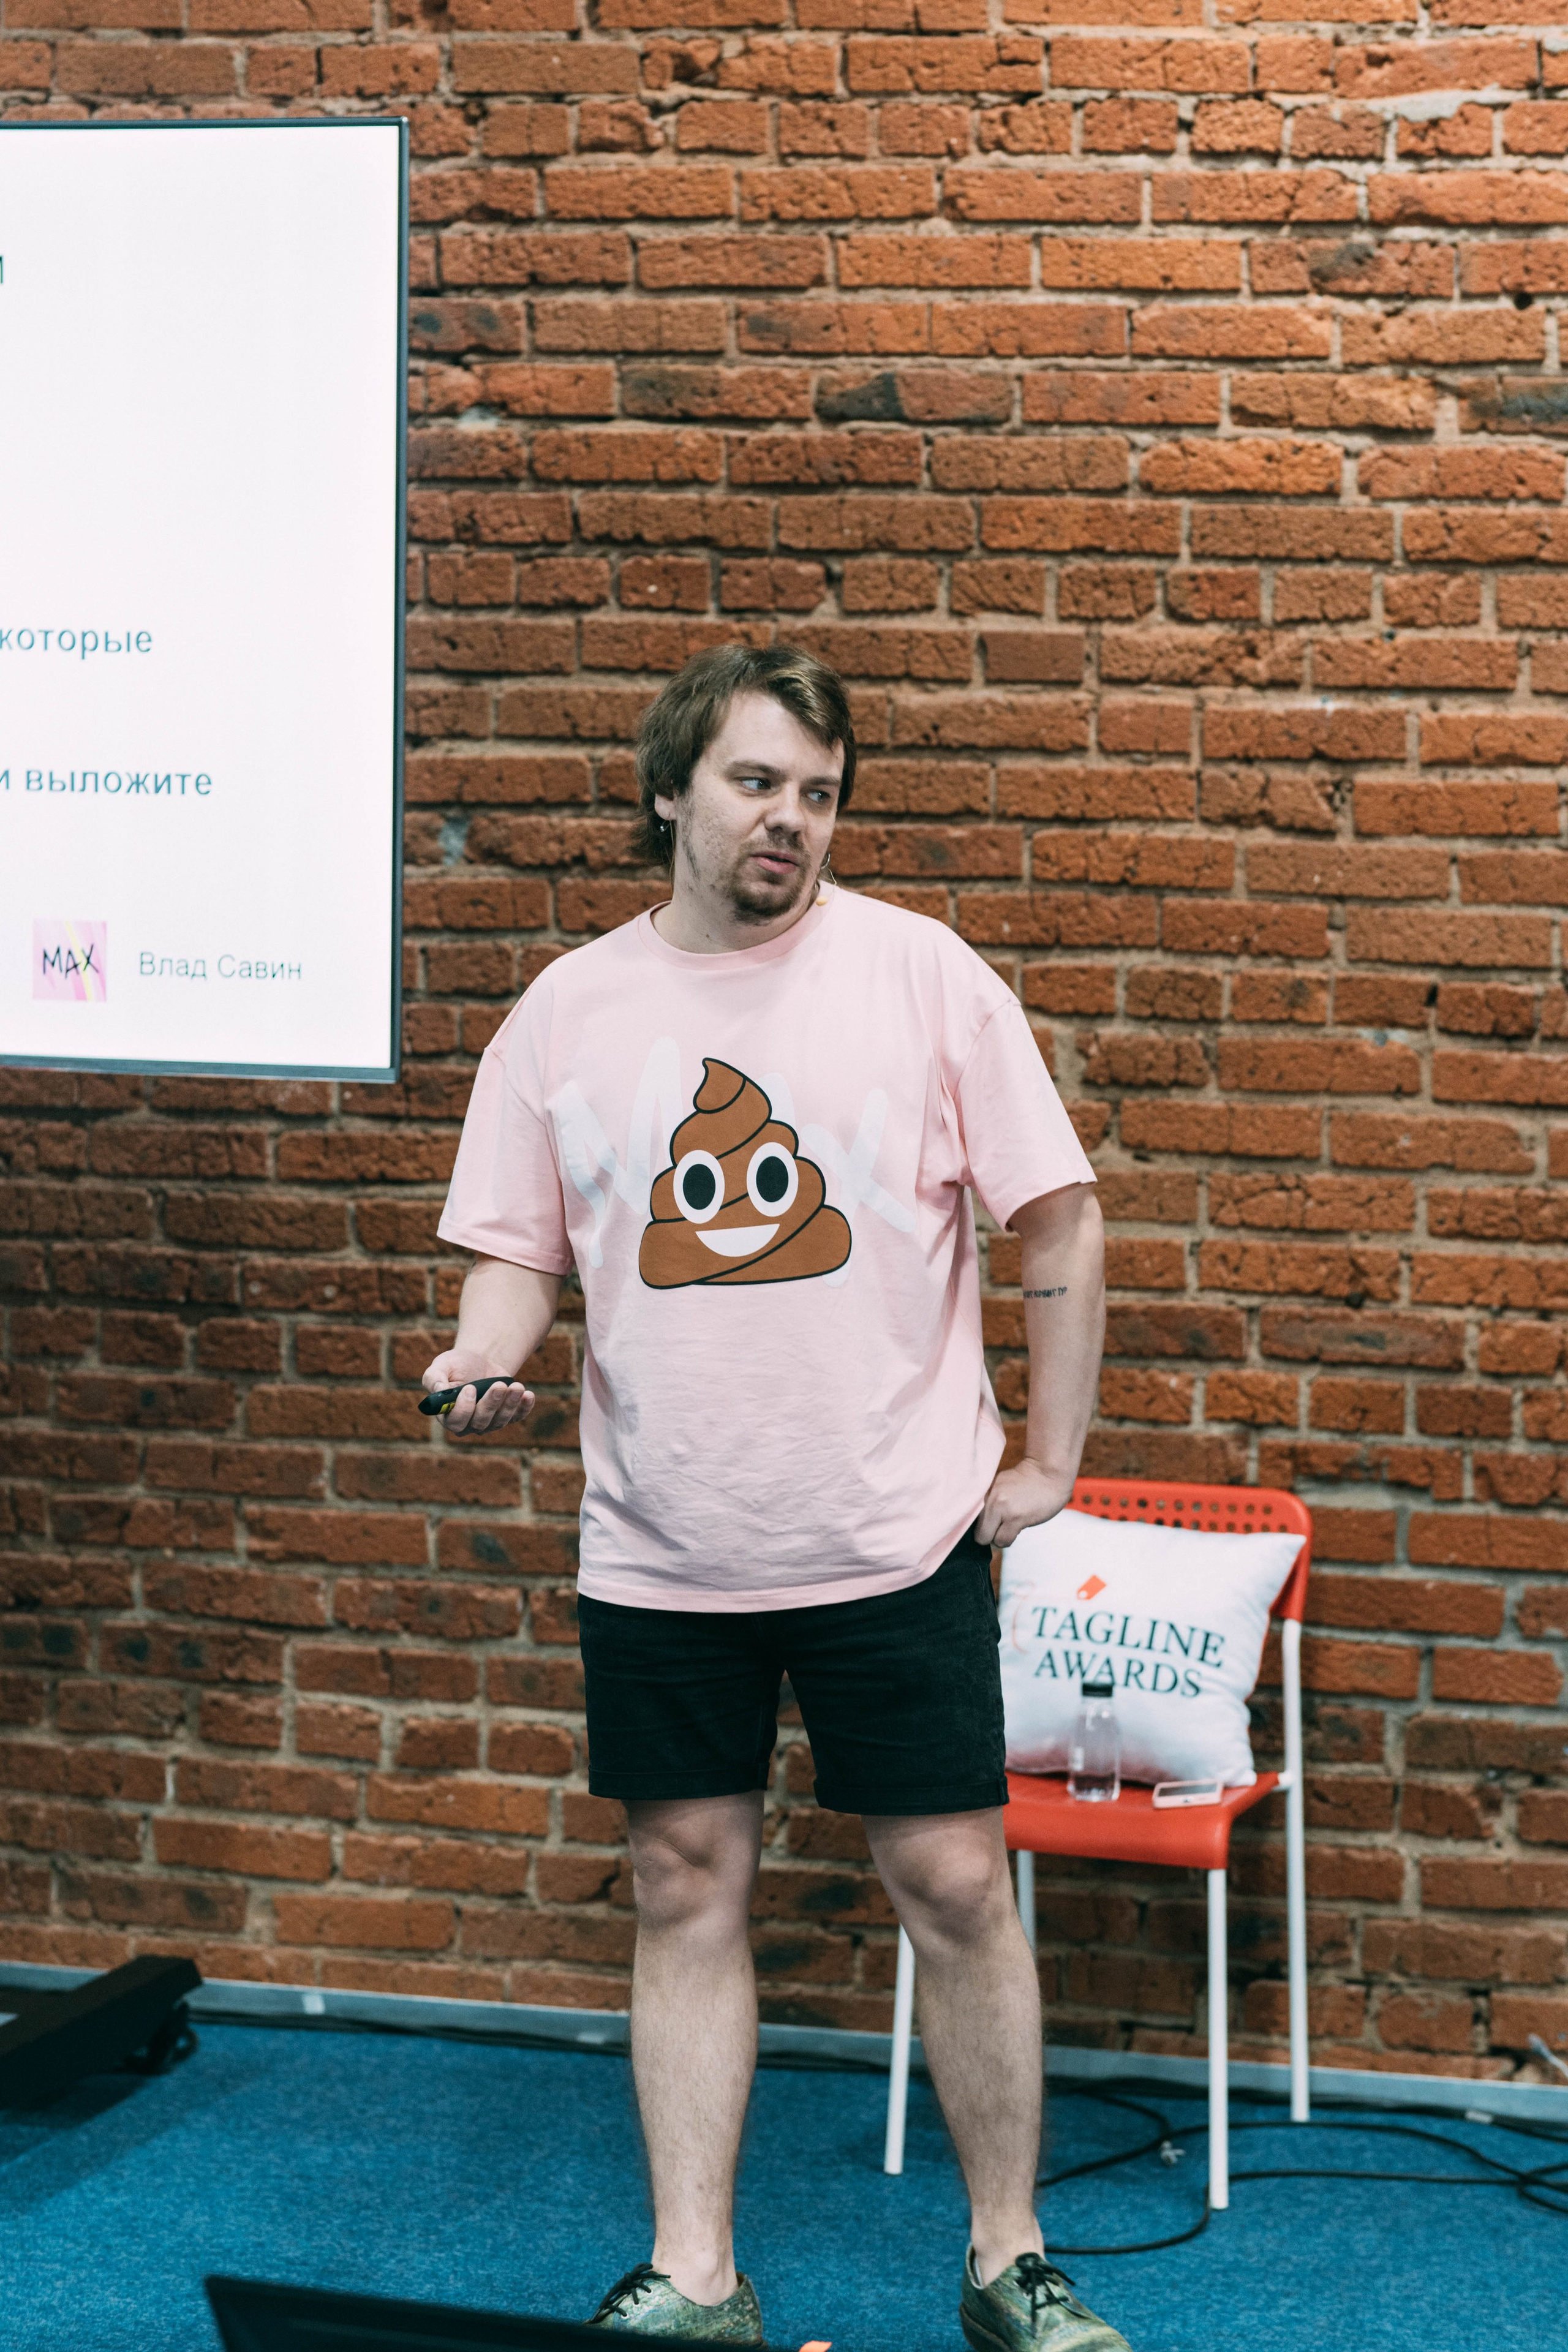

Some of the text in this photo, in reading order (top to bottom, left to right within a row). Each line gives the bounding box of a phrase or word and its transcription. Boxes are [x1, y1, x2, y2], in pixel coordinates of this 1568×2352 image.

[0, 628, 152, 660] которые
[26, 769, 212, 795] выложите
[42, 943, 99, 979] MAX
[140, 951, 302, 980] Влад Савин
[553, 1036, 916, 1288] MX
[1031, 1605, 1226, 1668] TAGLINE
[1034, 1649, 1202, 1698] AWARDS
